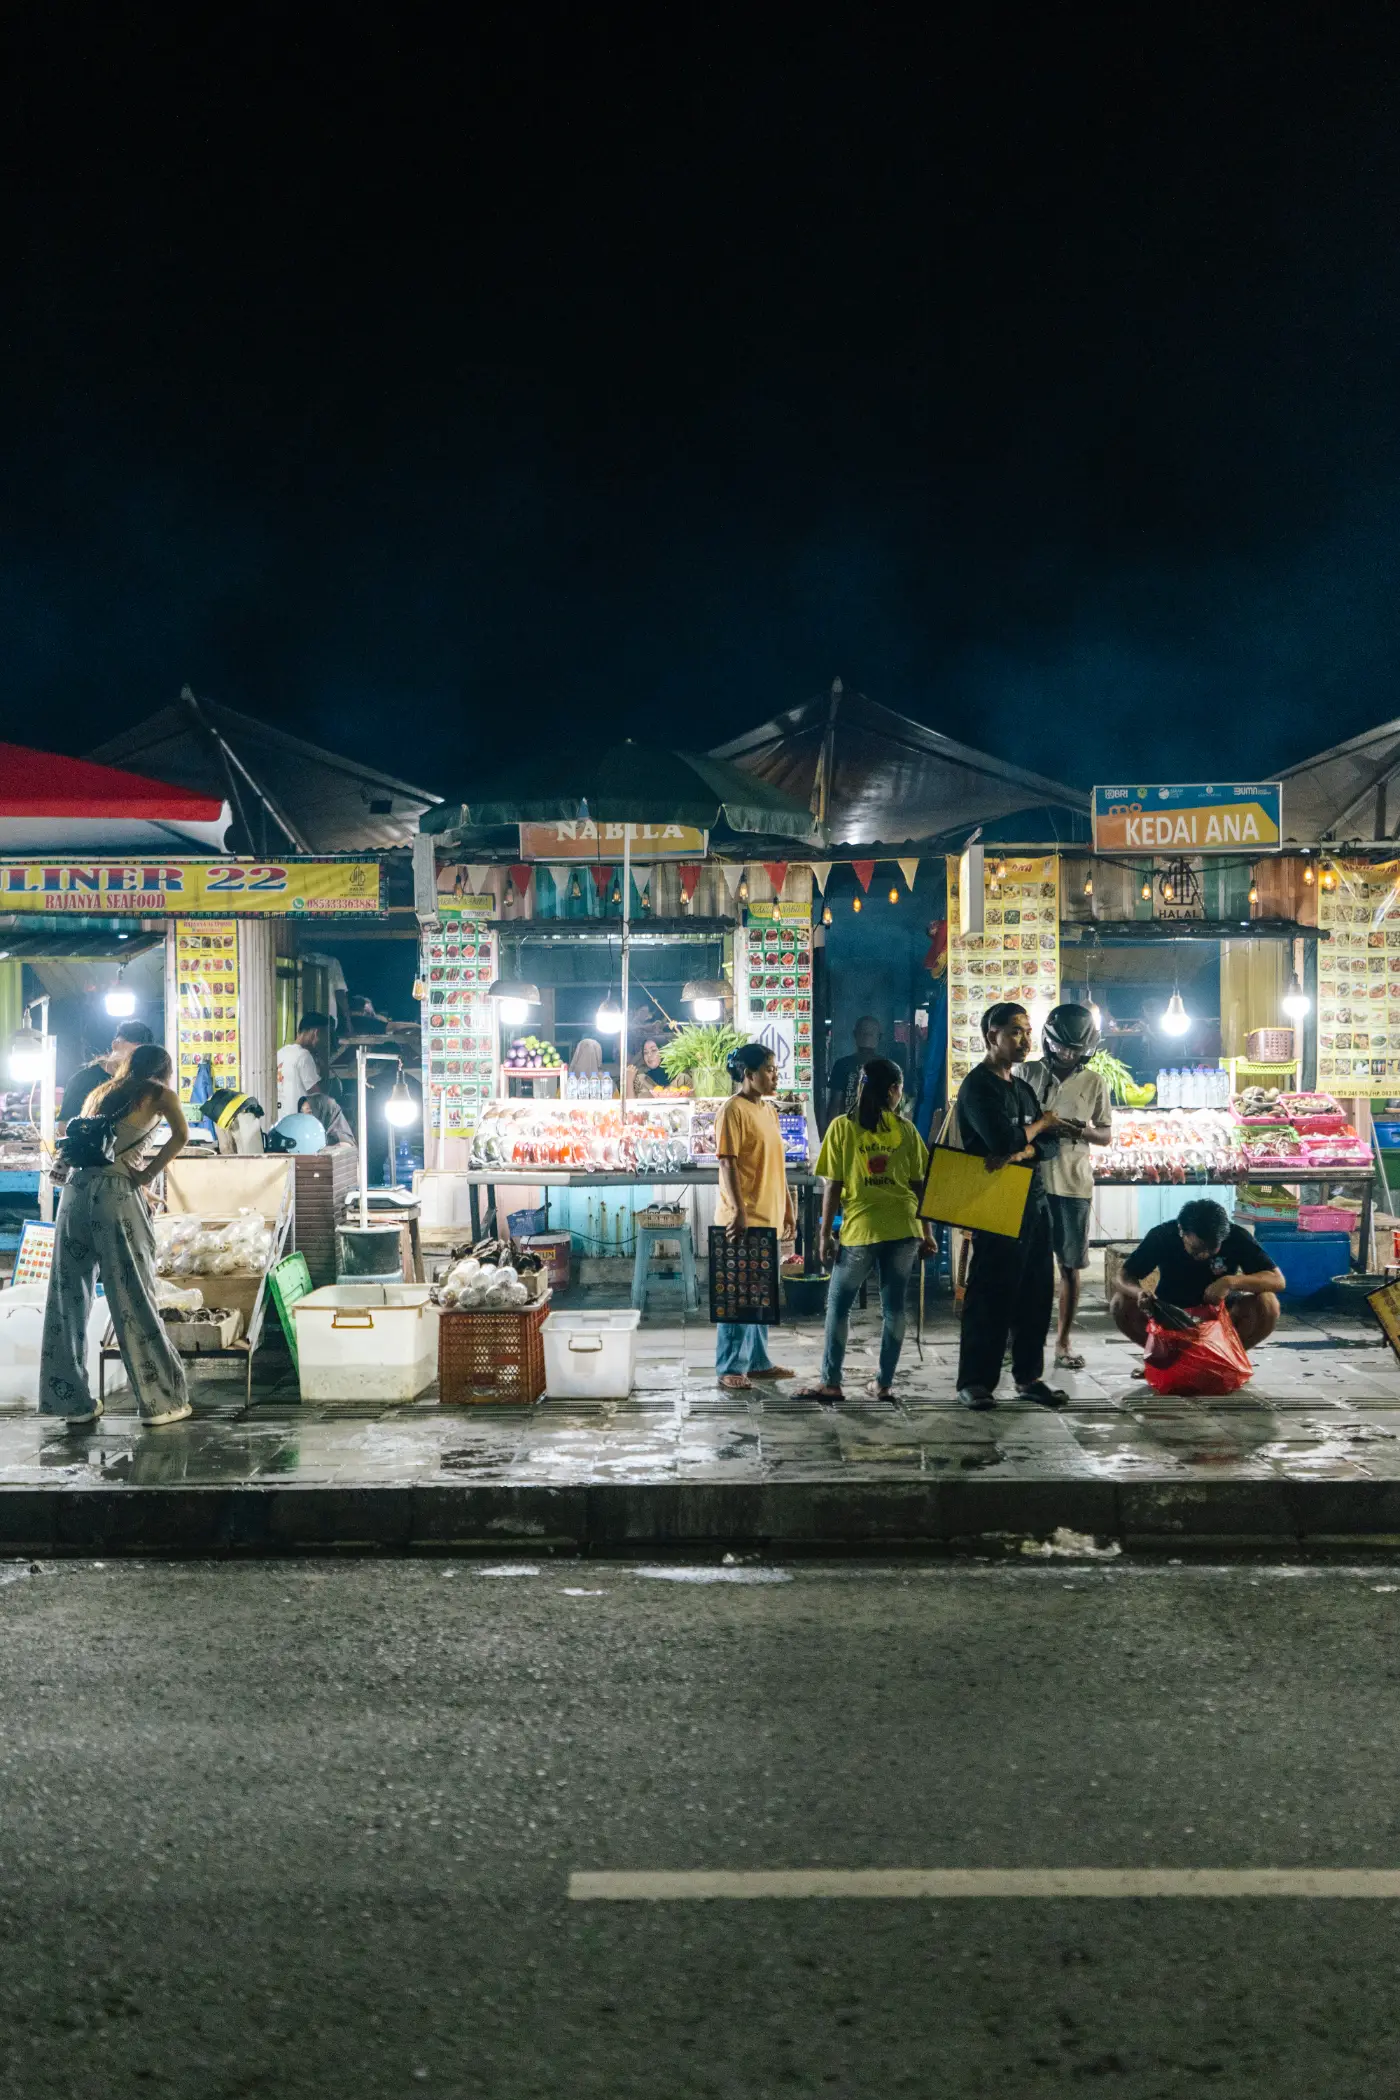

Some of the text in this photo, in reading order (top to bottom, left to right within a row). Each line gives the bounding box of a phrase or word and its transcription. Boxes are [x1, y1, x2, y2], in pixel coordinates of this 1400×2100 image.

[556, 820, 684, 841] NABILA
[1125, 813, 1260, 846] KEDAI ANA
[0, 867, 288, 893] LINER 22
[45, 893, 166, 911] RAJANYA SEAFOOD
[1159, 909, 1200, 919] HALAL
